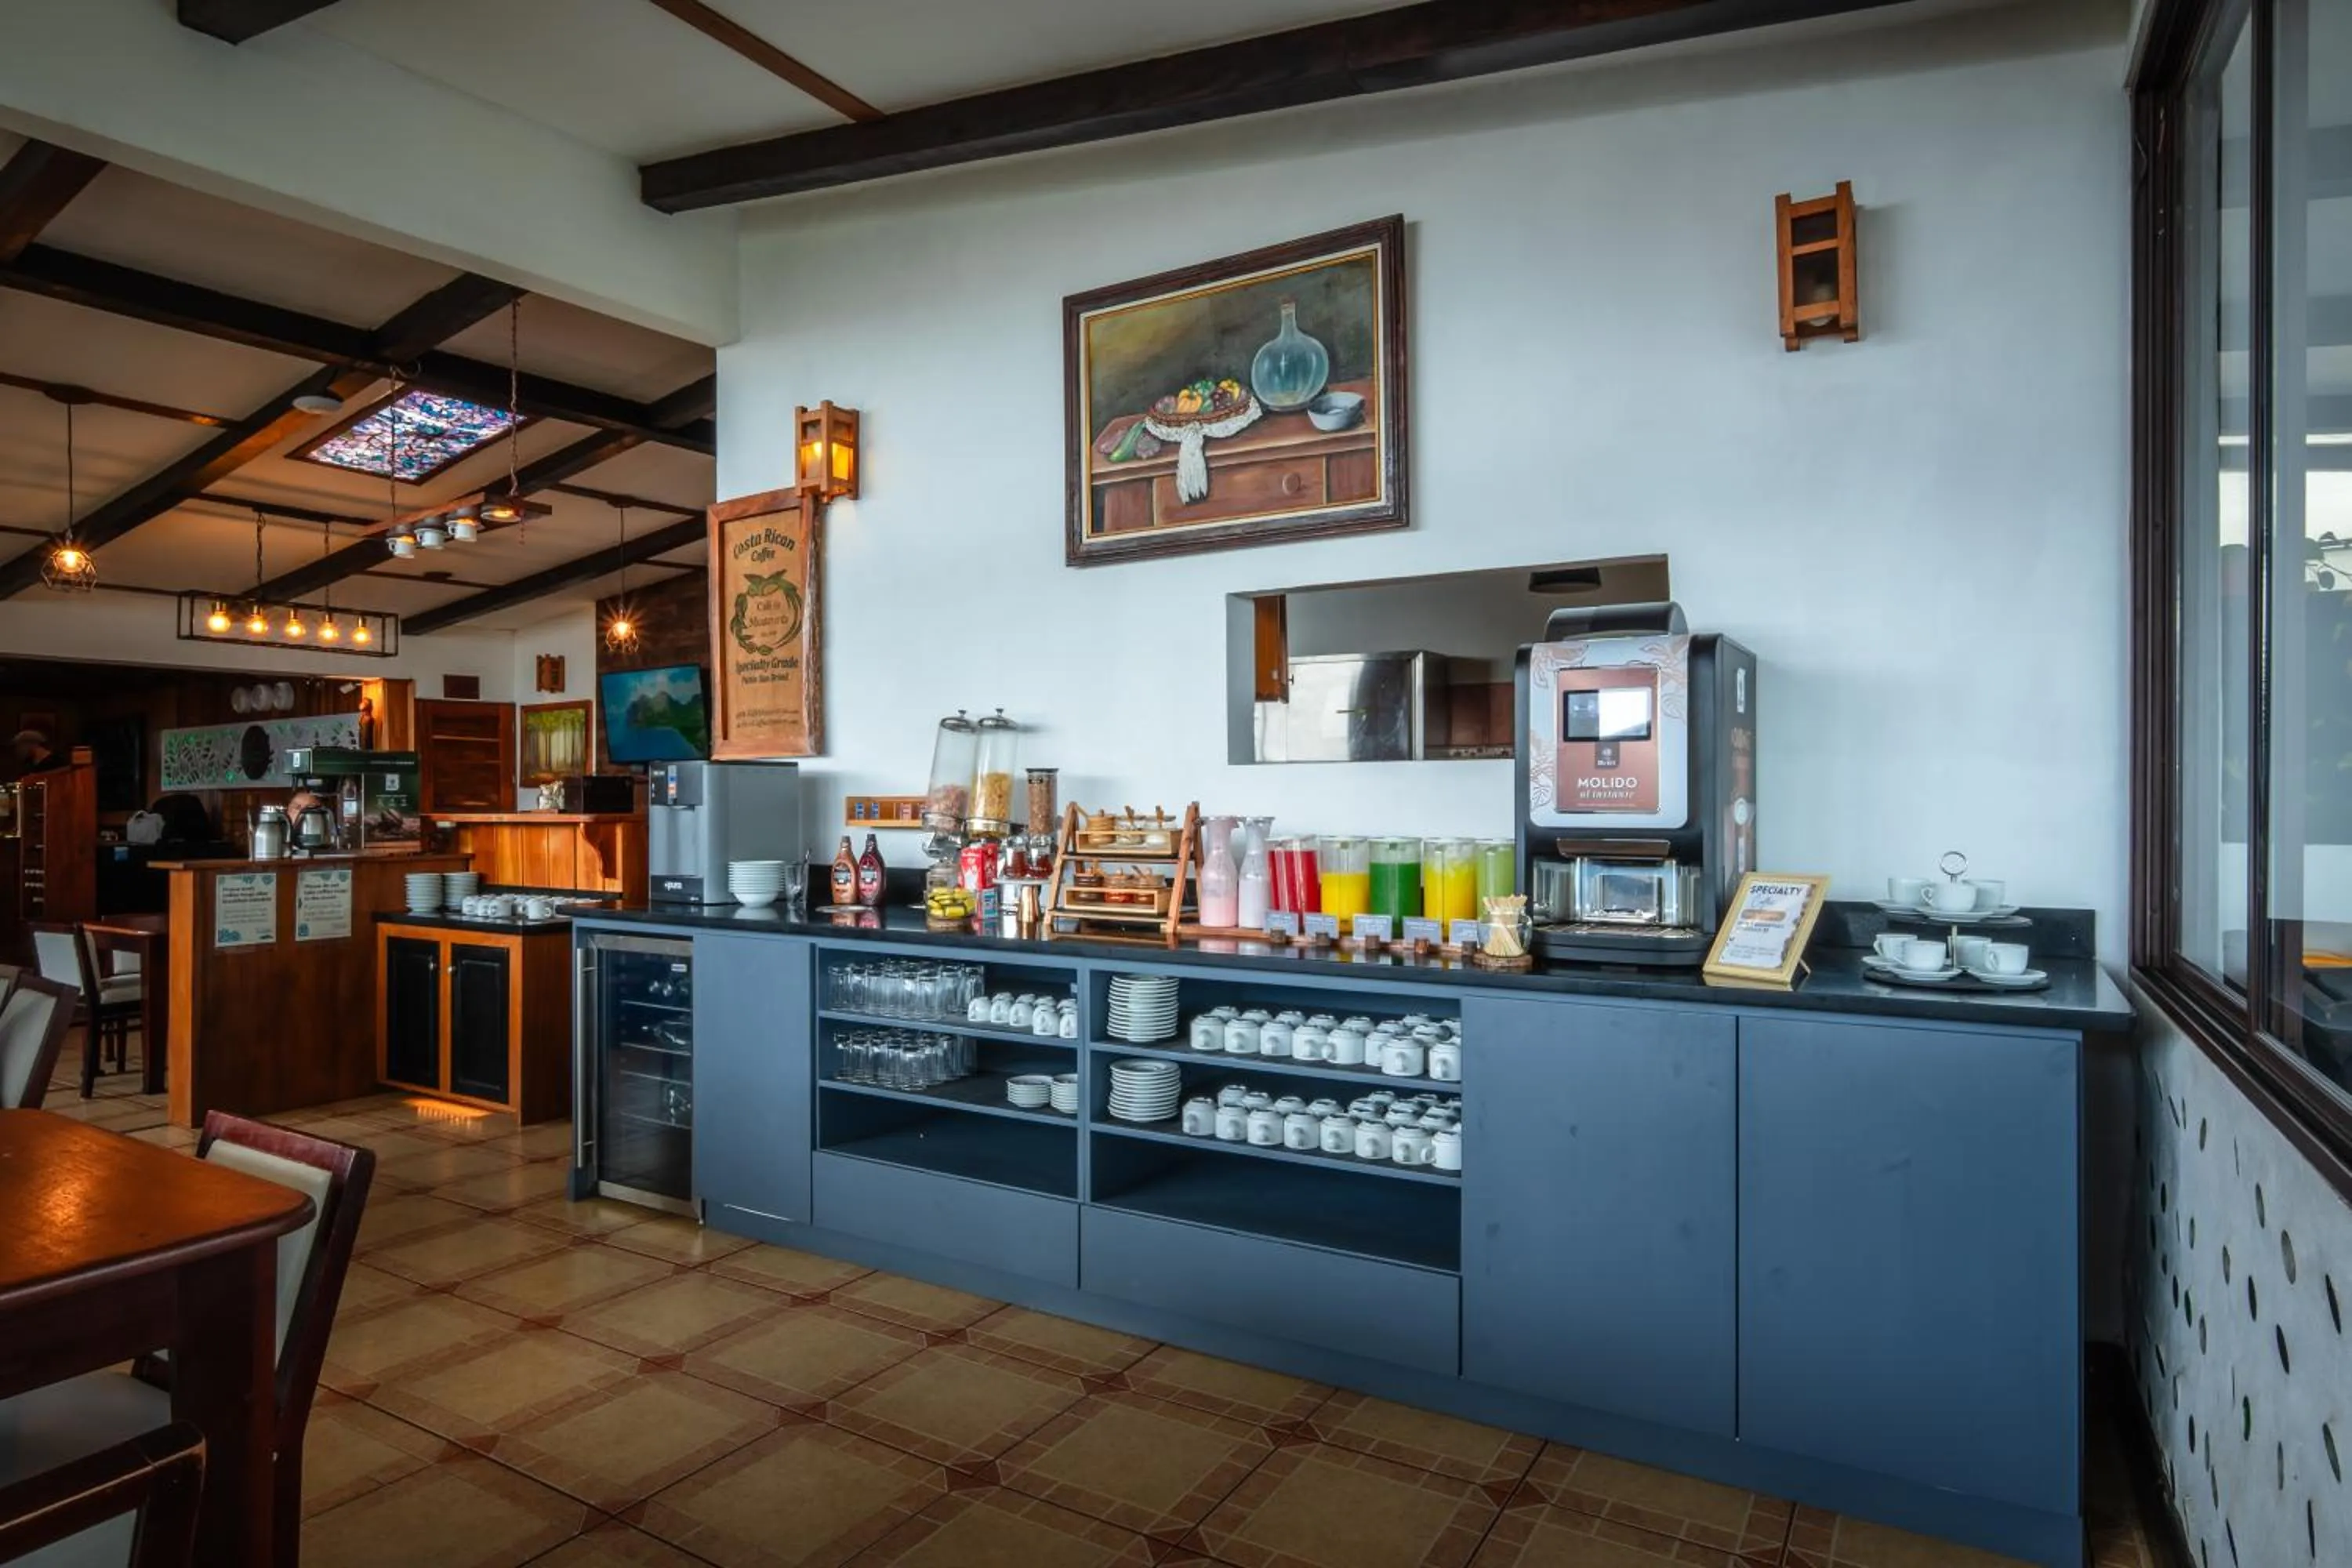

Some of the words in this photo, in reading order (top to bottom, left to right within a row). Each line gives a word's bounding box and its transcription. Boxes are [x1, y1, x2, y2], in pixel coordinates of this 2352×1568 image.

[733, 533, 761, 560] Costa
[764, 528, 795, 551] Rican
[751, 547, 775, 563] Coffee
[771, 655, 798, 669] Grade
[1577, 777, 1638, 788] MOLIDO
[1750, 885, 1802, 895] SPECIALTY
